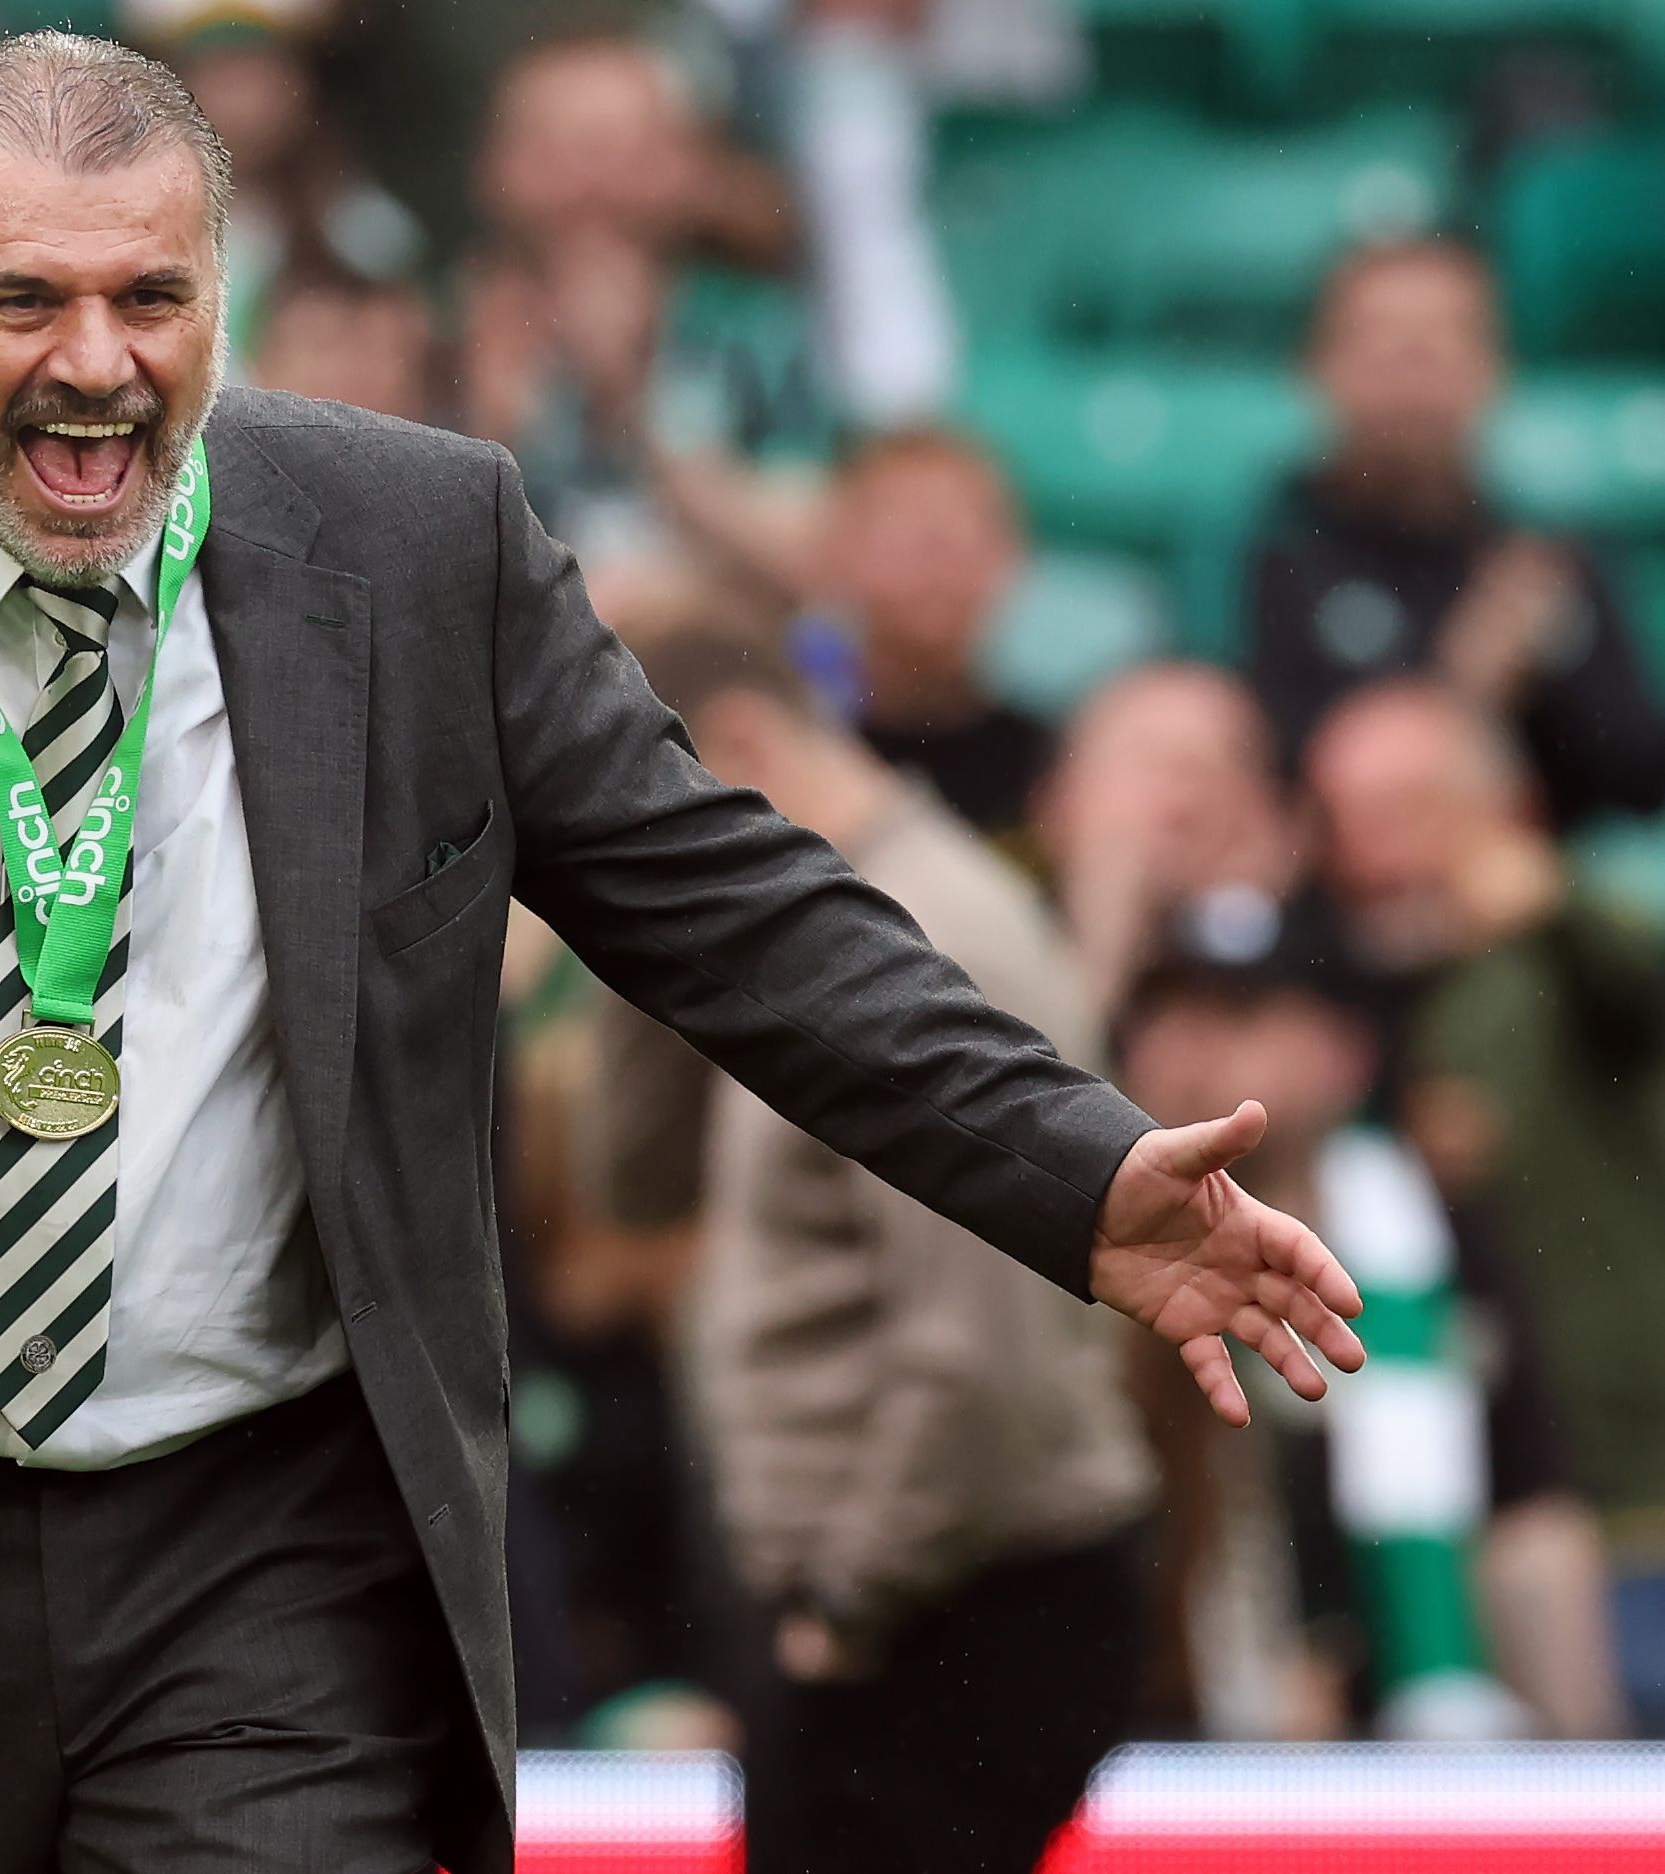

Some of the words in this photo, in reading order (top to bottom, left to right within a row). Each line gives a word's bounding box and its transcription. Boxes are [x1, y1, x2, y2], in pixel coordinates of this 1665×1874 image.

[8, 780, 62, 926] cinch
[59, 766, 130, 906] cinch
[38, 1059, 104, 1092] cinch
